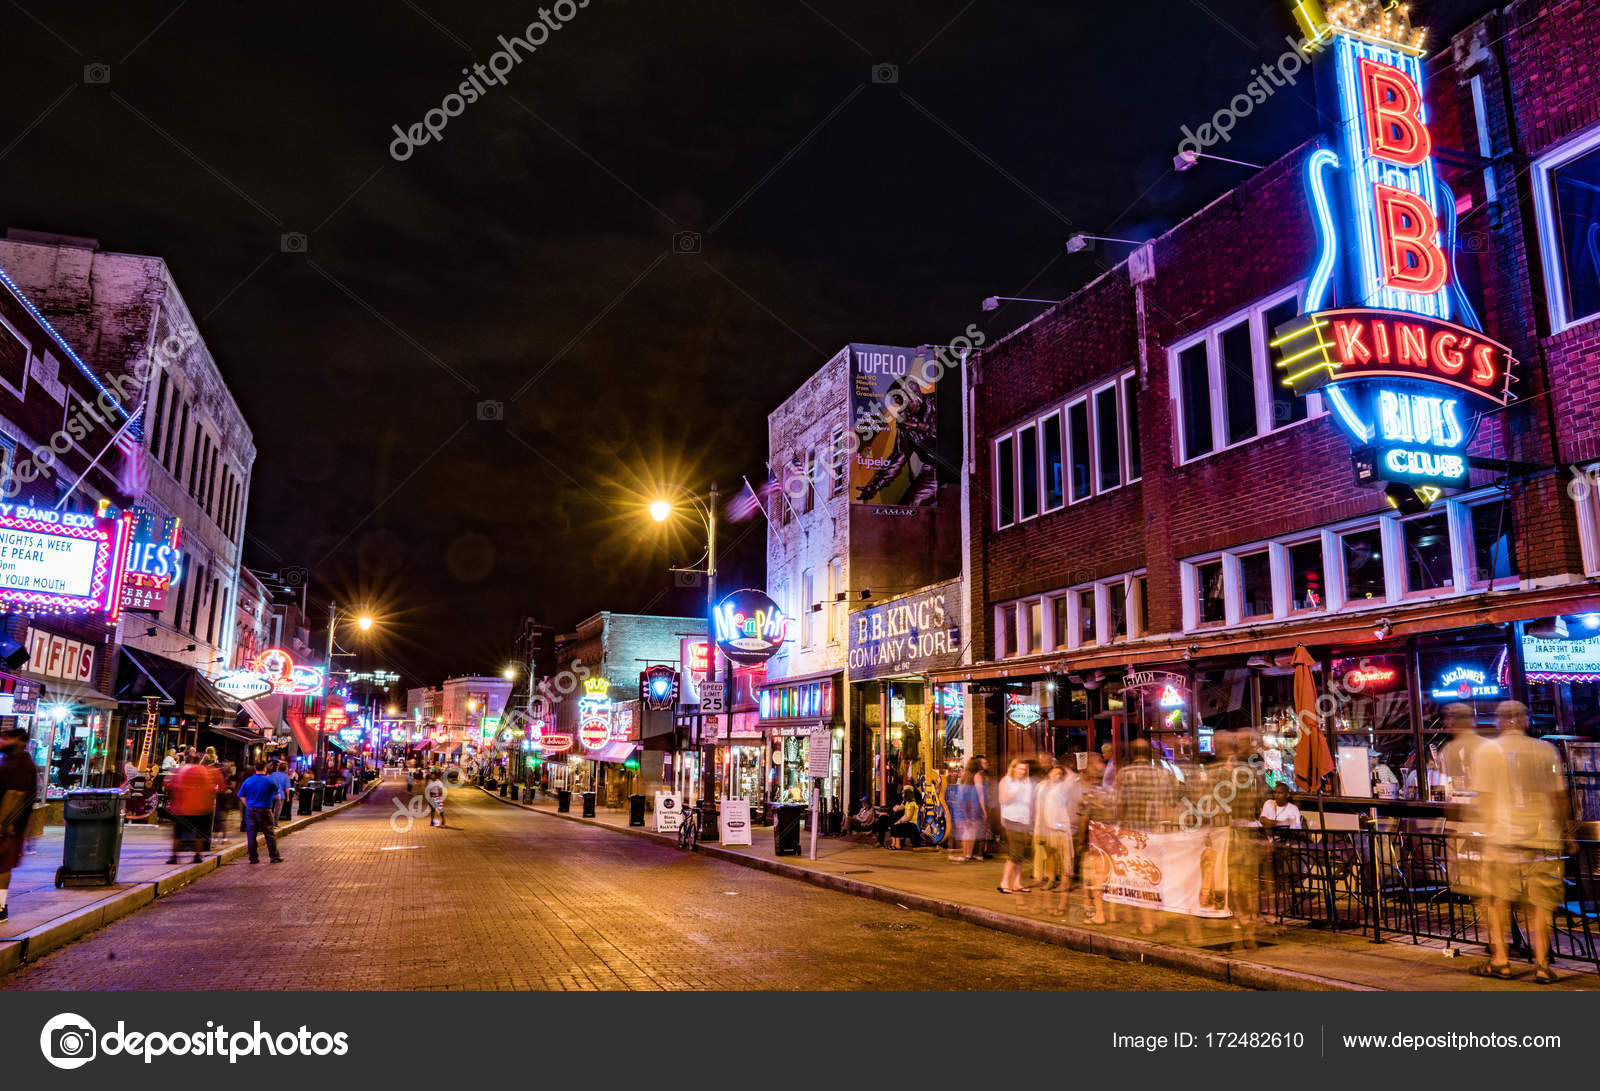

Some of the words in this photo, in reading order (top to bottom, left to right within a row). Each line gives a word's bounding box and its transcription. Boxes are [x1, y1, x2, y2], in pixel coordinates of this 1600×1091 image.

[1357, 56, 1431, 167] B
[1373, 183, 1448, 295] B
[856, 352, 905, 375] TUPELO
[1333, 318, 1495, 387] KING'S
[1379, 390, 1462, 447] BLUES
[856, 453, 891, 469] tupelo
[1386, 449, 1464, 478] CLUB
[16, 506, 59, 523] BAND
[62, 513, 95, 528] BOX
[875, 508, 913, 516] LAMAR
[12, 547, 45, 562] PEARL
[37, 538, 43, 548] A
[48, 539, 72, 552] WEEK
[5, 574, 30, 586] YOUR
[33, 577, 66, 591] MOUTH
[714, 602, 786, 644] Memphis
[849, 638, 905, 669] COMPANY
[908, 627, 959, 659] STORE
[1472, 686, 1498, 697] FIRE
[702, 698, 722, 710] 25
